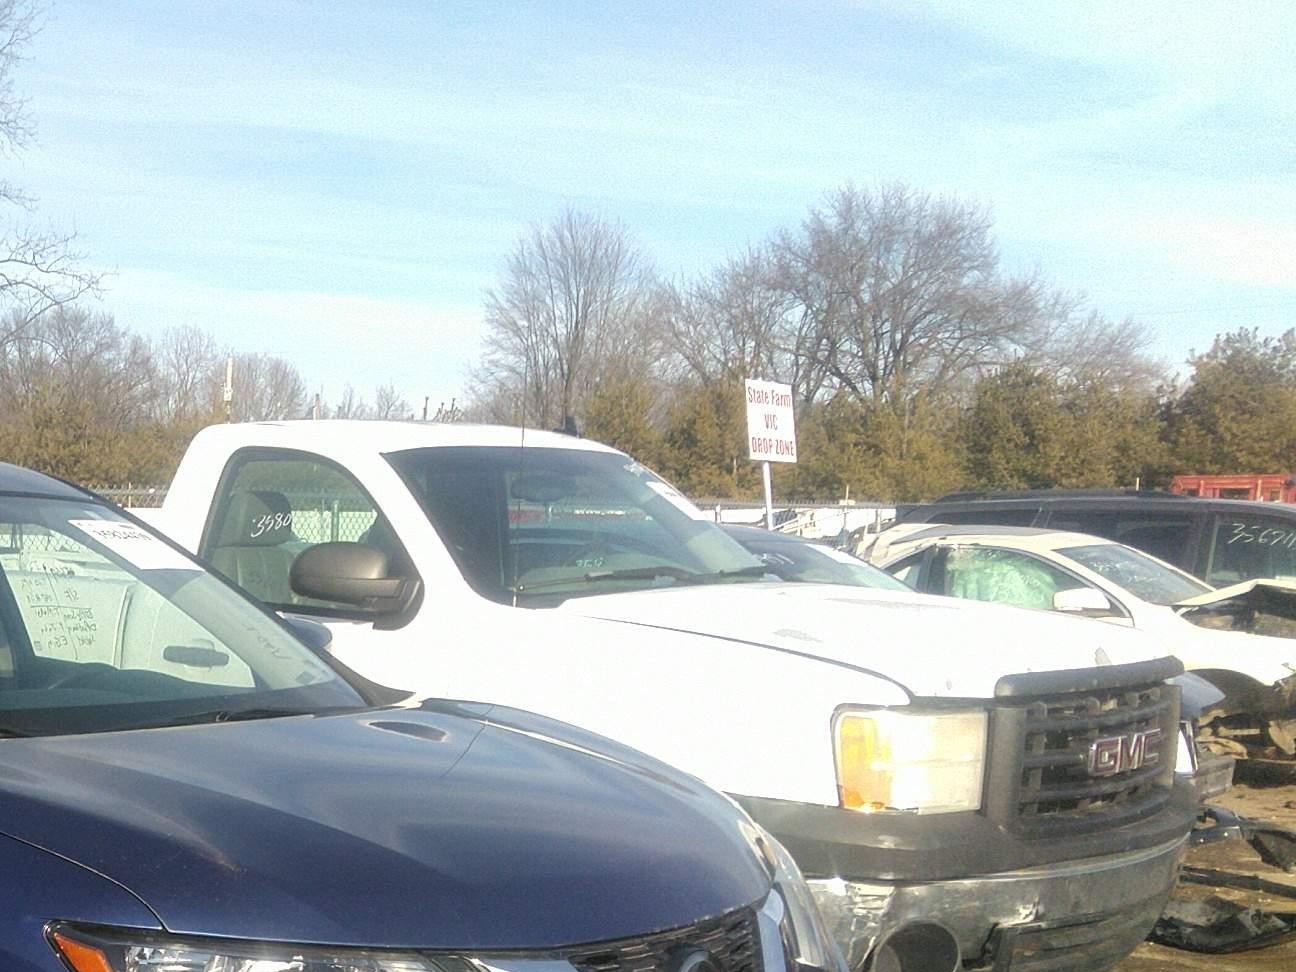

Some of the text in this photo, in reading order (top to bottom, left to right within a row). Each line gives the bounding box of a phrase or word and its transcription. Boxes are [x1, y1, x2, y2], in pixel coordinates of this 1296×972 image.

[747, 386, 791, 408] State Farm
[764, 414, 778, 431] VIC
[751, 436, 795, 457] DROP ZONE
[1088, 728, 1161, 777] GMC
